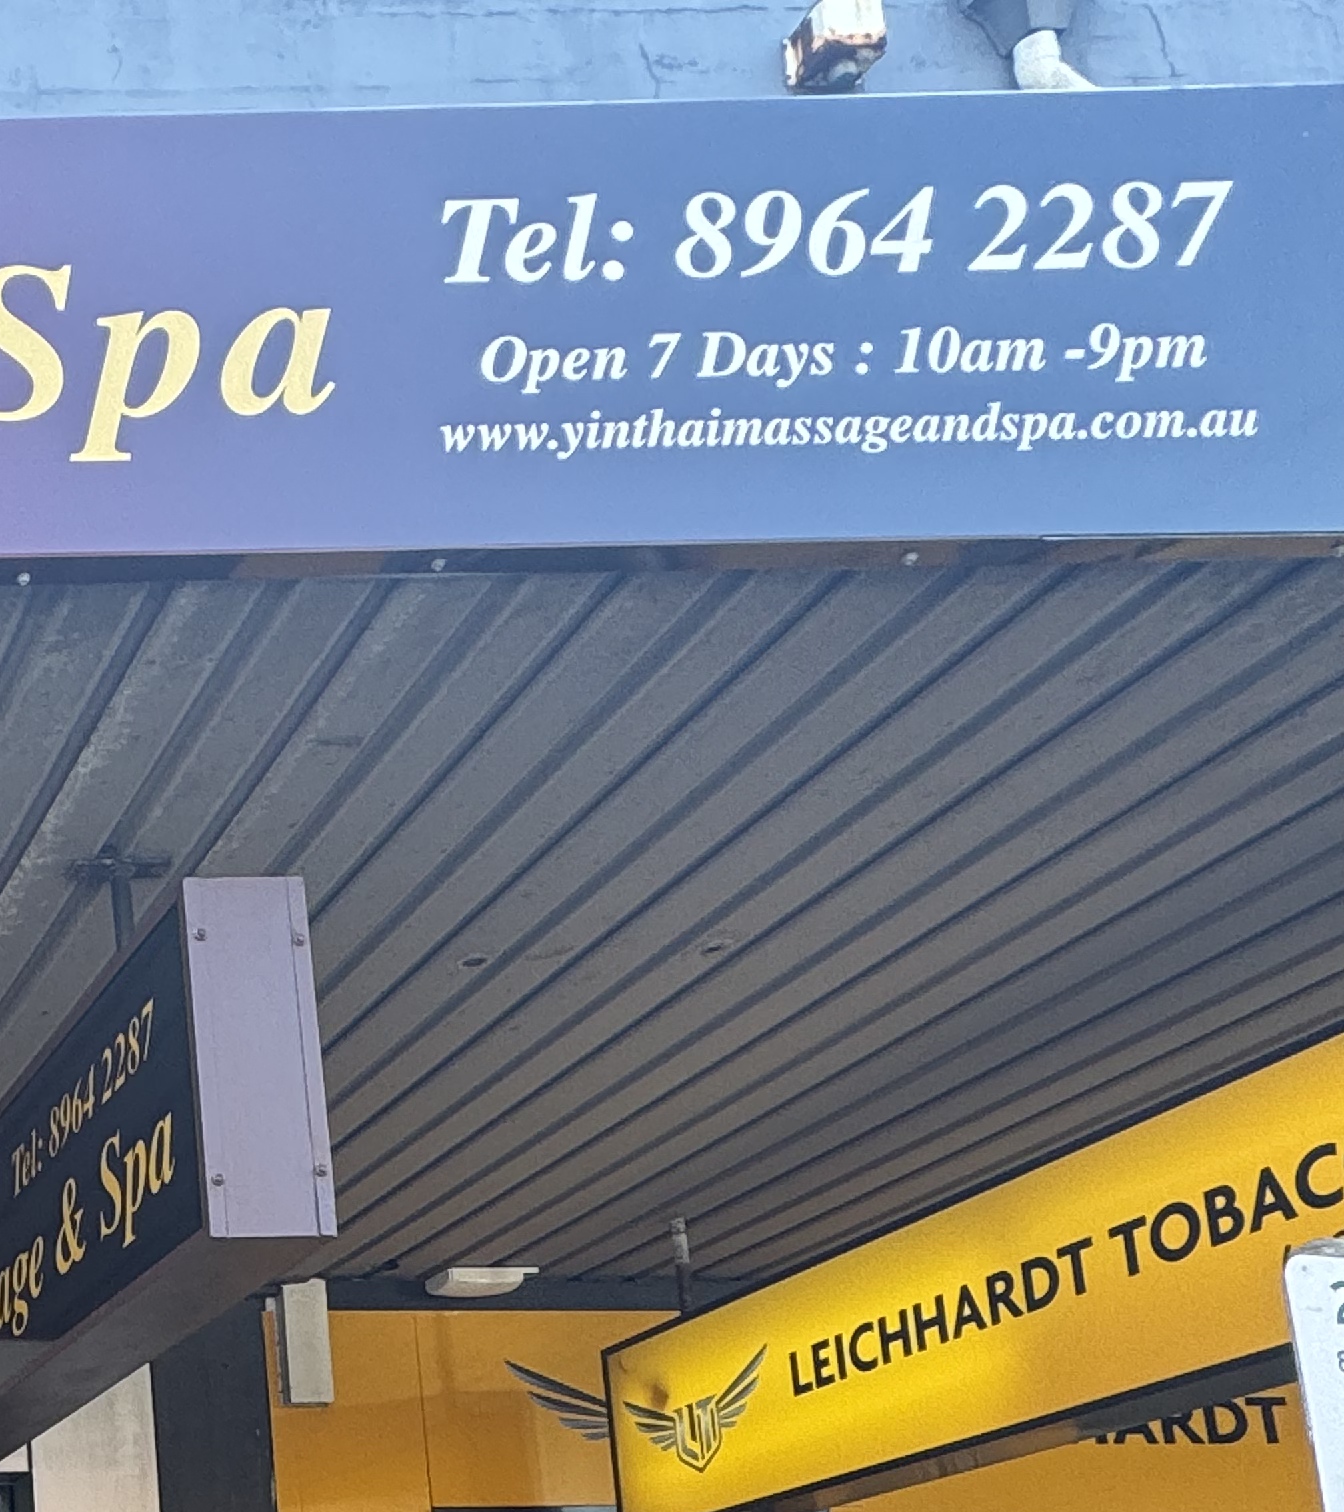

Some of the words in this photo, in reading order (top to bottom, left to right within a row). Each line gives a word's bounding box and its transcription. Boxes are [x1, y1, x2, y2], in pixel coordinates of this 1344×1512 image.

[440, 193, 635, 284] Tel:
[674, 186, 937, 279] 8964
[966, 179, 1233, 271] 2287
[479, 334, 627, 394] Open
[648, 331, 681, 380] 7
[697, 330, 835, 389] Days
[893, 325, 1046, 376] 10am
[1063, 322, 1207, 384] -9pm
[439, 402, 1260, 460] www.yinthaimassageandspa.com.au
[12, 1129, 43, 1198] Tel:
[48, 1064, 96, 1158] 8964
[101, 997, 155, 1104] 2287
[54, 1177, 86, 1276] &
[100, 1111, 176, 1249] Spa
[789, 1238, 1093, 1398] LEICHHARDT
